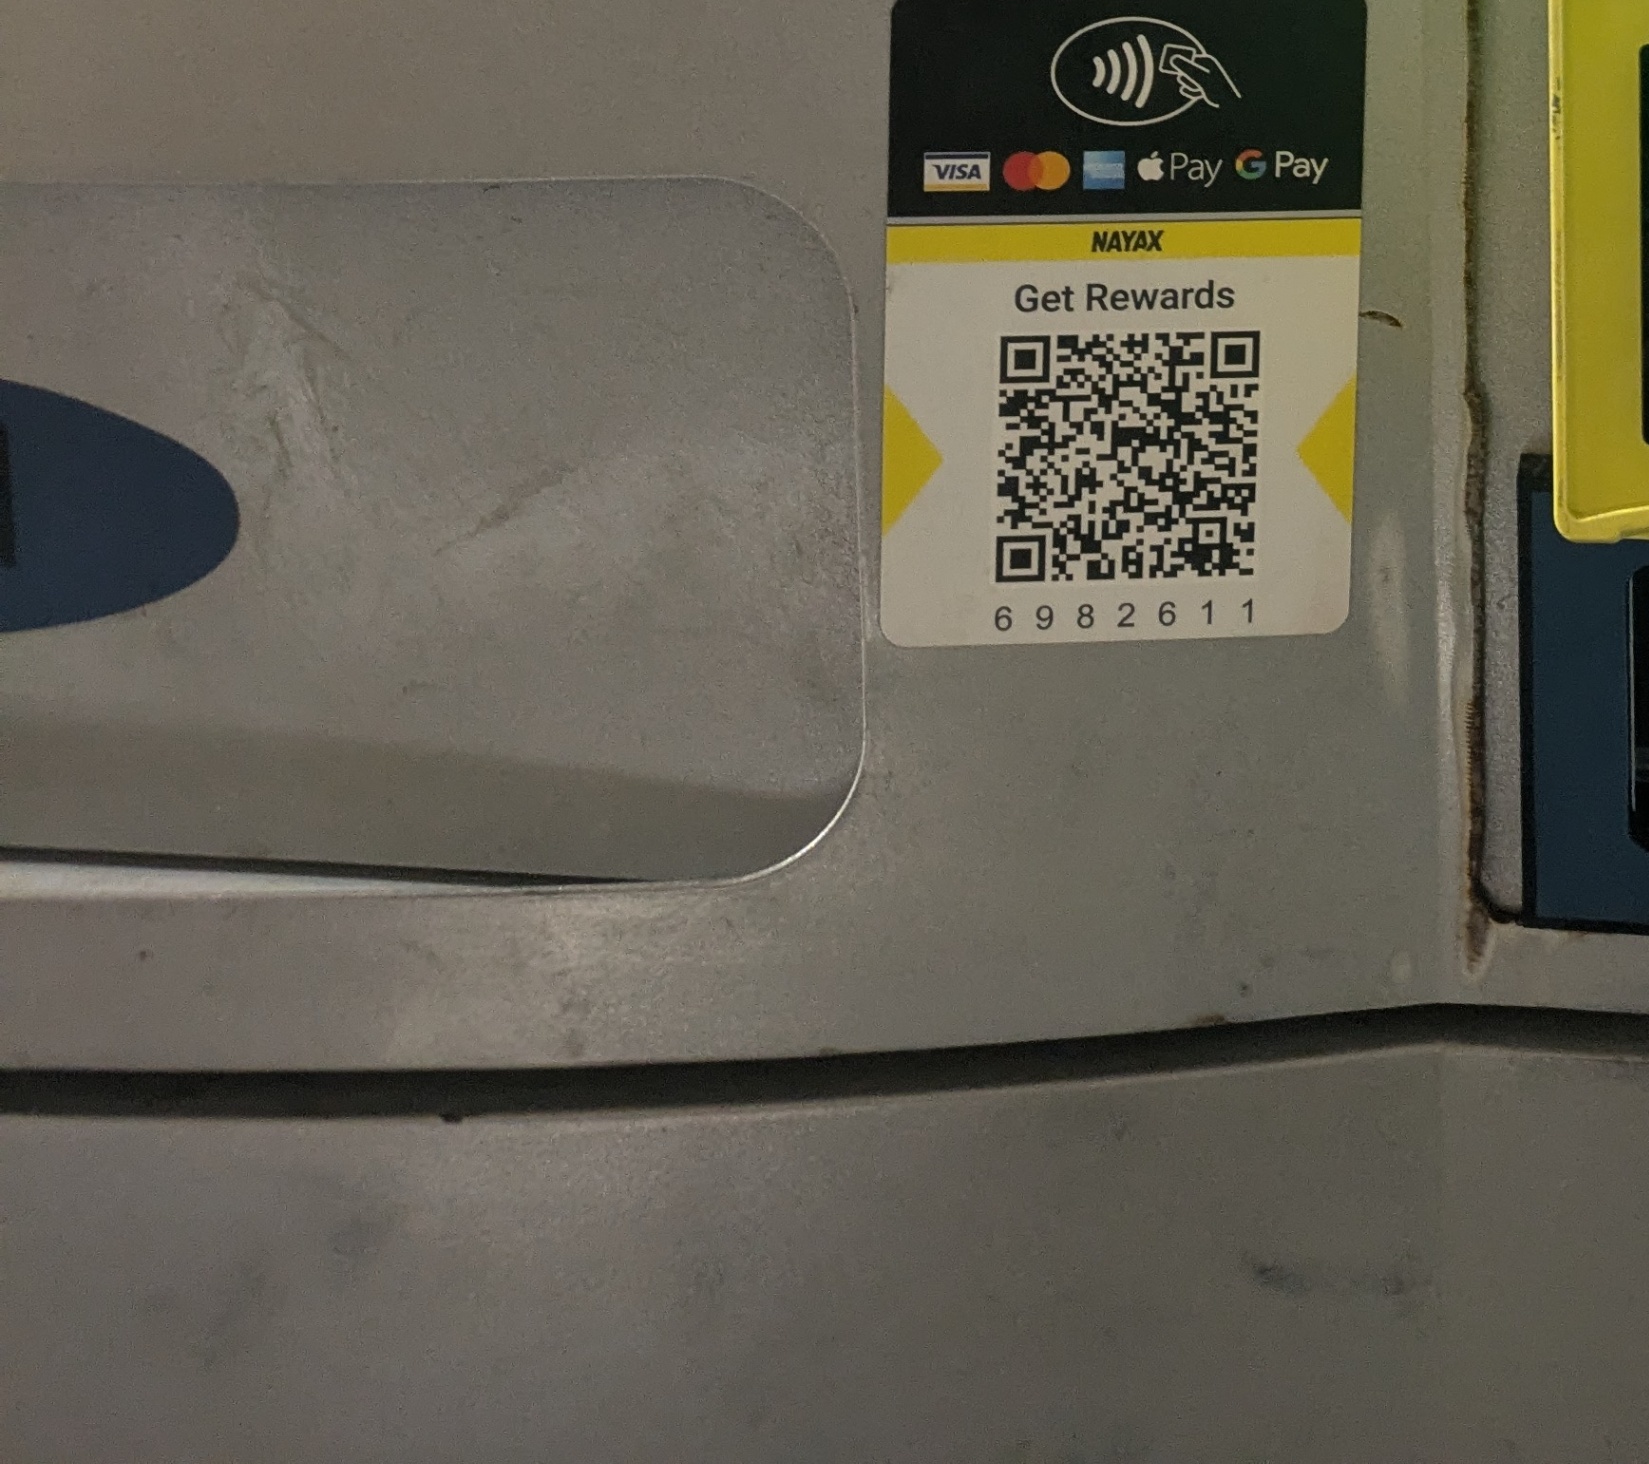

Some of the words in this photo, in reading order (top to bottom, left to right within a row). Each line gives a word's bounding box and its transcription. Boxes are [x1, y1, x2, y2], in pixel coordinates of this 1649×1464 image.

[933, 164, 982, 180] VISA
[1170, 152, 1223, 187] Pay
[1235, 149, 1267, 179] G
[1275, 150, 1329, 184] Pay
[1091, 230, 1164, 253] NAYAX
[1014, 283, 1075, 313] Get
[1086, 279, 1235, 312] Rewards
